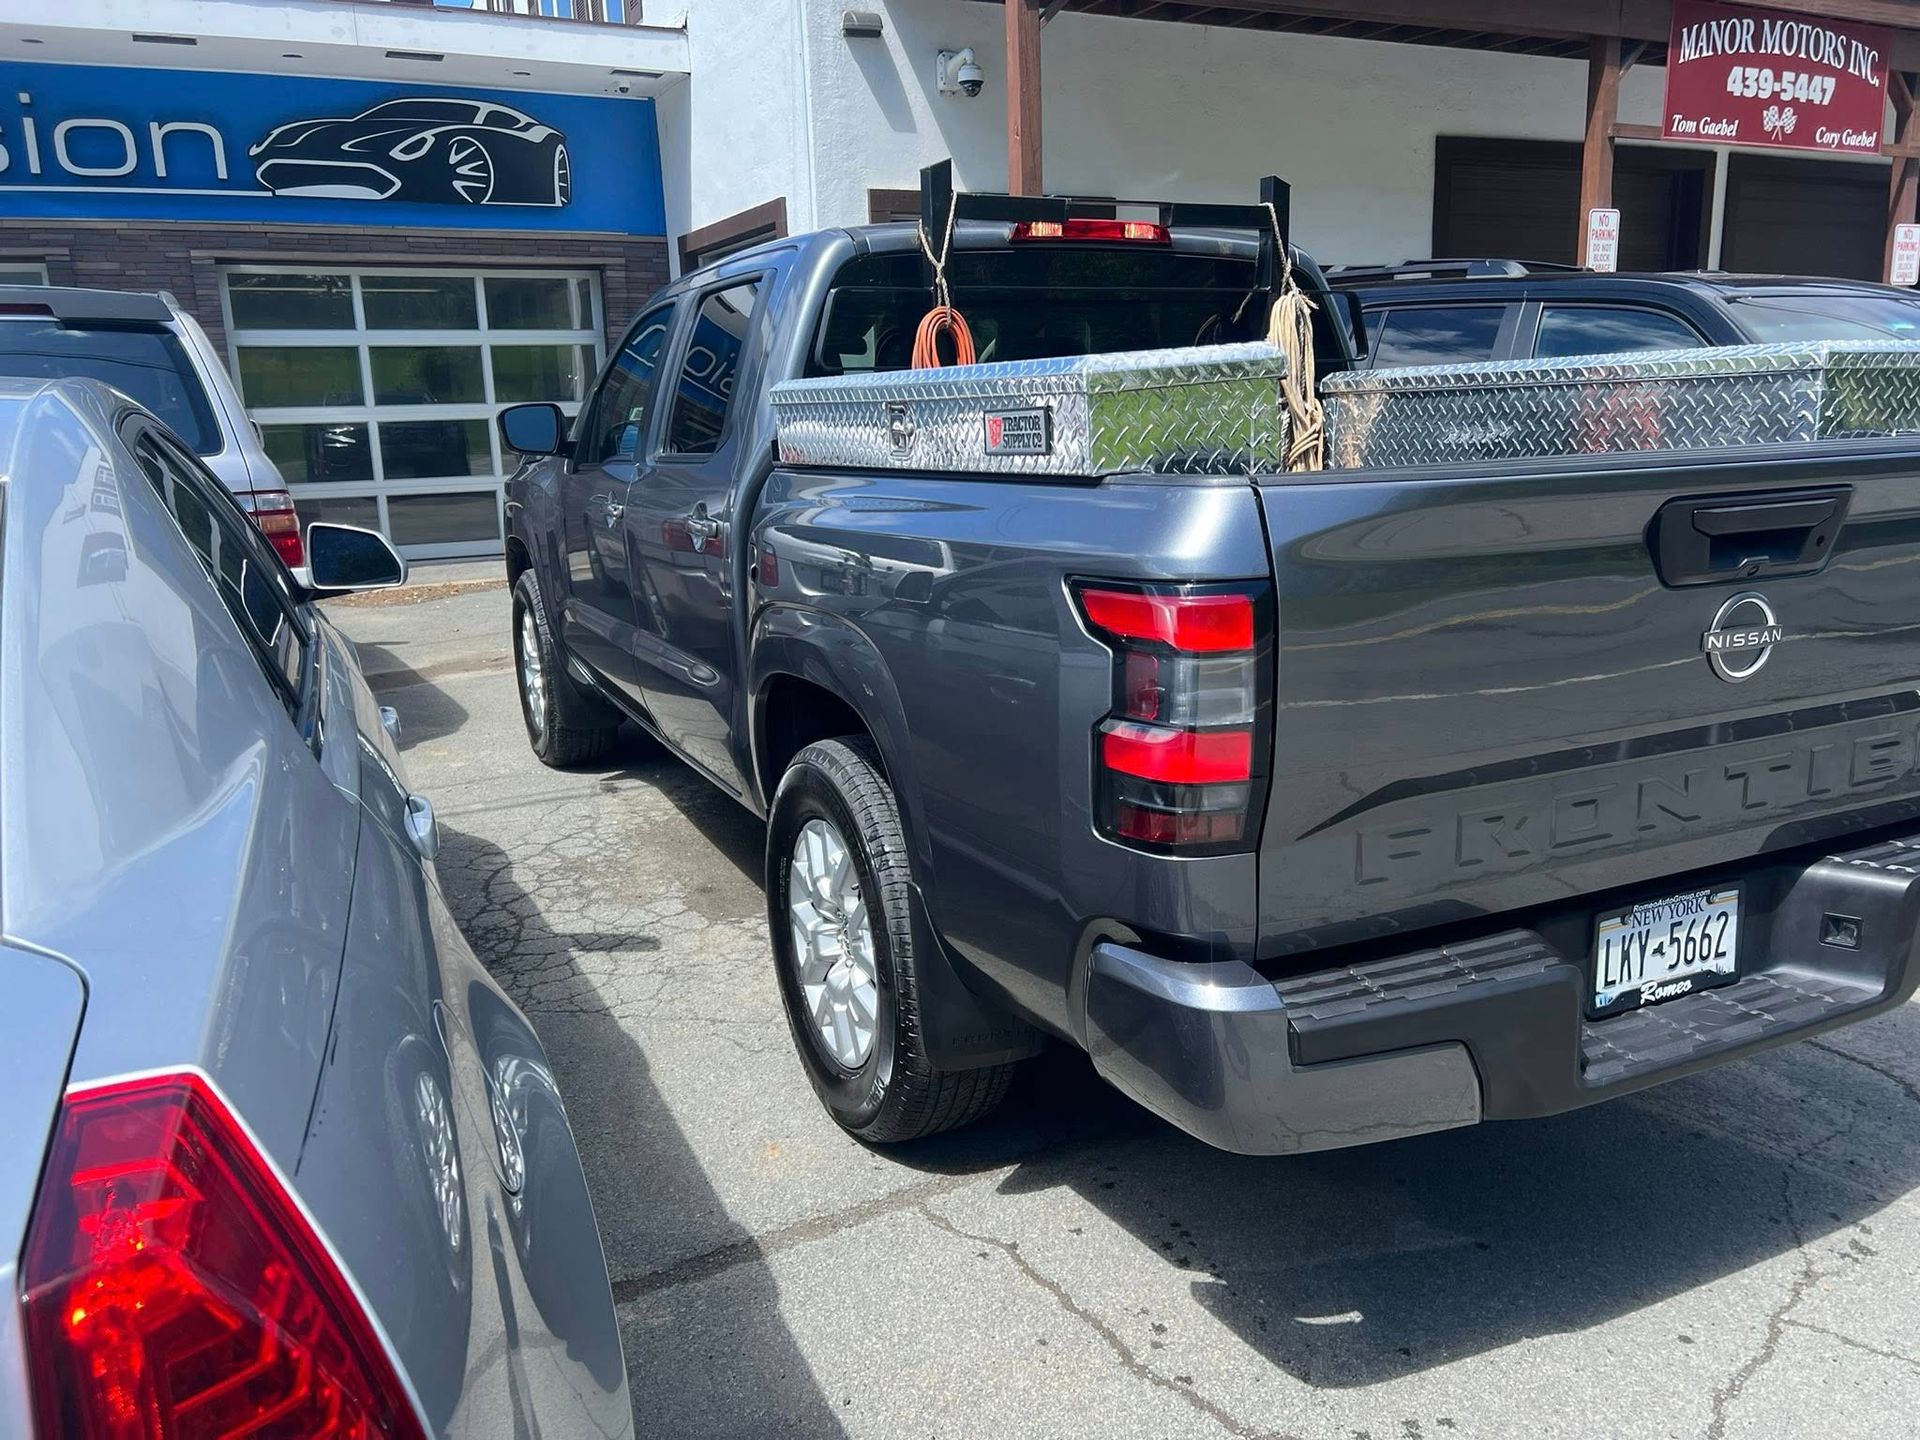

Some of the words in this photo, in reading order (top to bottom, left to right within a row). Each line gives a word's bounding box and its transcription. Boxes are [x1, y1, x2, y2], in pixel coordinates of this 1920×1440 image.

[1678, 18, 1755, 64] MANOR
[1759, 19, 1847, 69] MOTORS
[1848, 40, 1880, 87] INC.
[1727, 66, 1836, 105] 439-5447
[0, 92, 228, 180] ion
[1671, 115, 1697, 133] Tom
[1699, 117, 1739, 137] Gaebel
[1815, 127, 1841, 148] Cory
[1842, 129, 1877, 148] Gaebel
[1598, 214, 1610, 227] NO
[1592, 229, 1615, 240] PARKING
[1002, 415, 1041, 432] TRACTOR
[1003, 433, 1031, 449] SUPPLY
[1707, 627, 1782, 649] NISSAN
[1354, 724, 1920, 885] FRONTIE
[1631, 907, 1665, 929] NEW
[1667, 898, 1704, 920] YORK
[1633, 889, 1711, 914] RomeoAutoGroup.com
[1604, 928, 1650, 988] LKY
[1667, 911, 1729, 970] 5662
[1640, 979, 1693, 1005] Romeo
